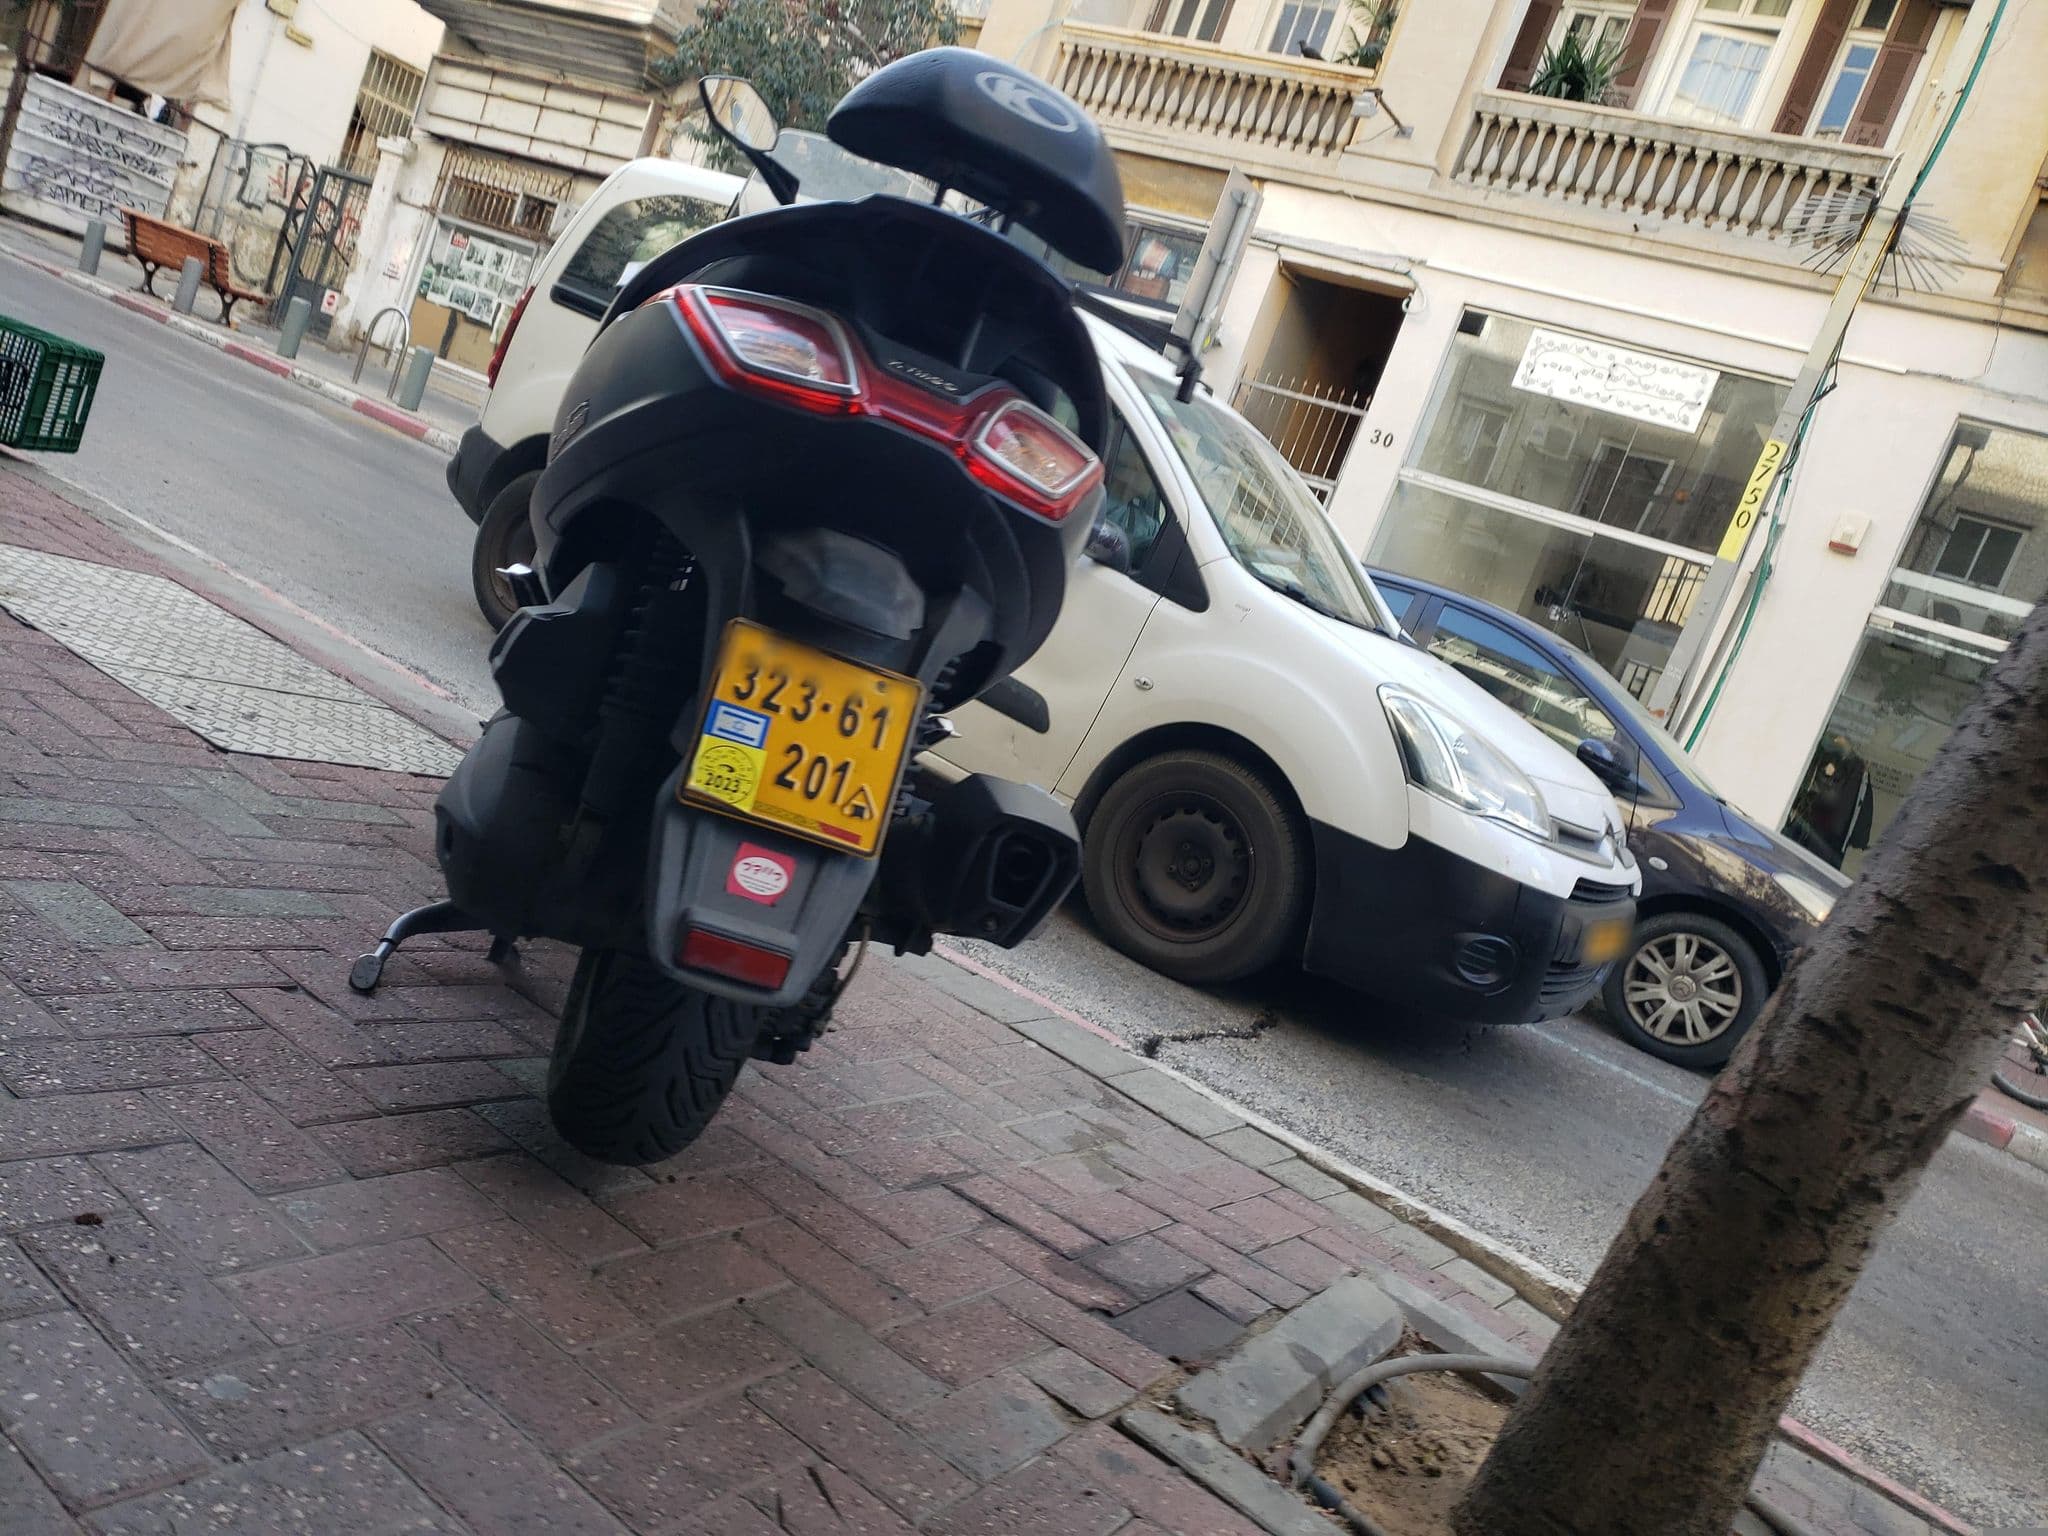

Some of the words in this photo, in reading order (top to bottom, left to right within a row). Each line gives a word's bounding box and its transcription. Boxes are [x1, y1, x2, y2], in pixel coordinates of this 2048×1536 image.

[1370, 429, 1394, 448] 30
[1736, 443, 1781, 529] 2750
[704, 772, 740, 793] 2023
[775, 743, 851, 804] 201
